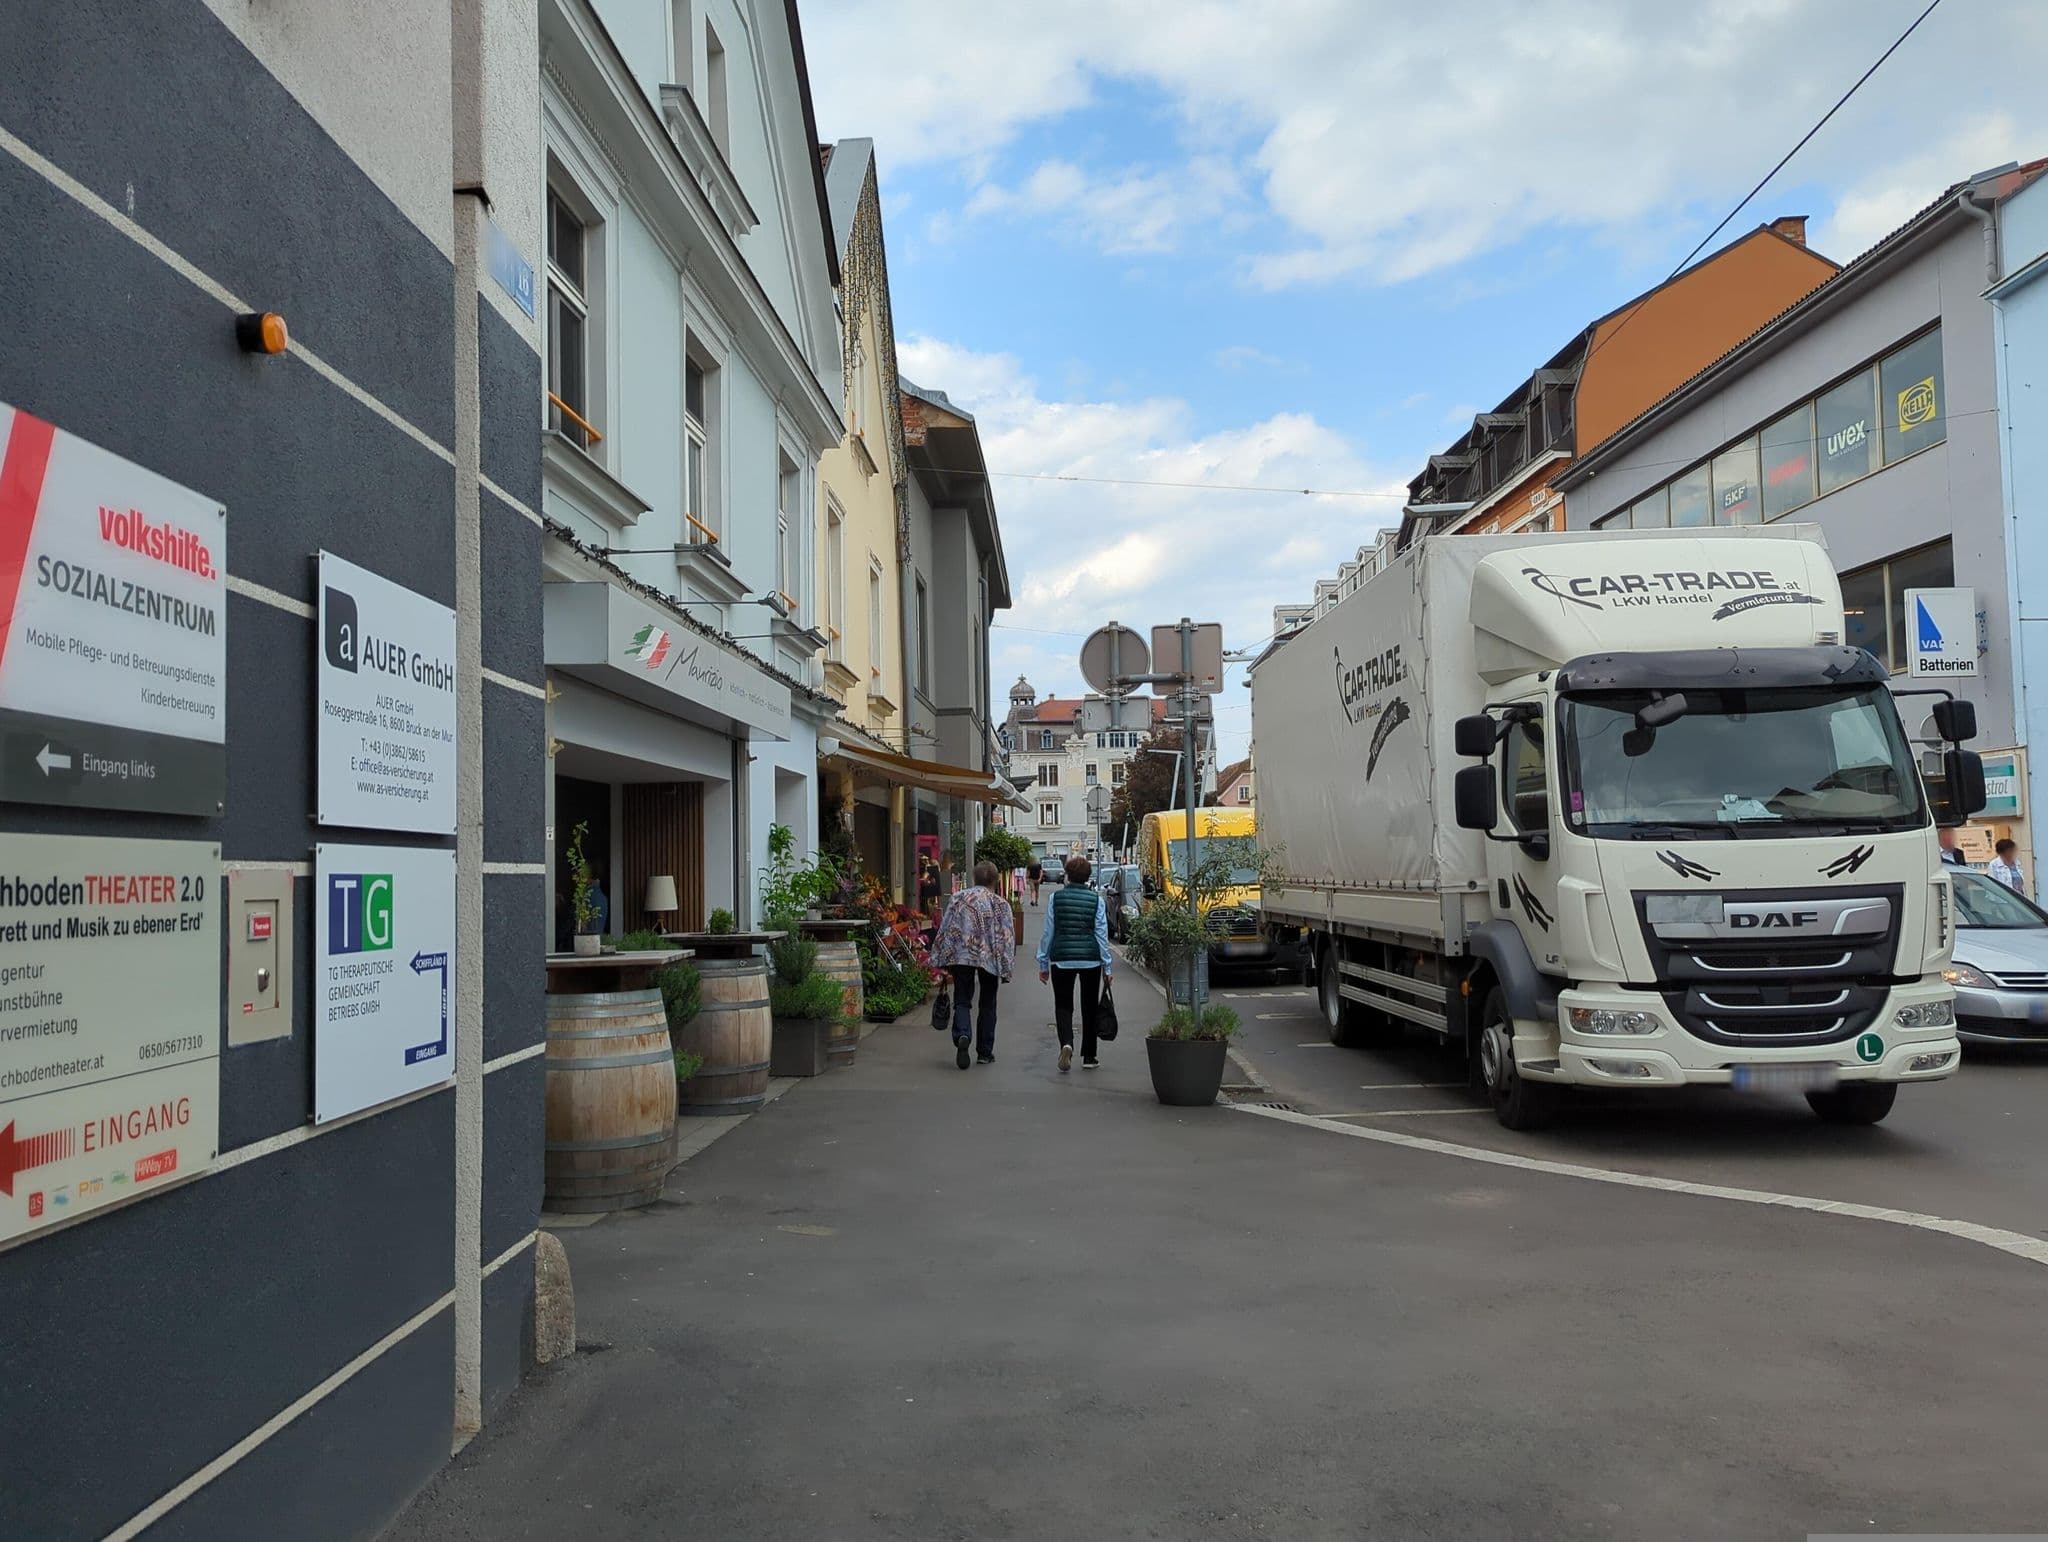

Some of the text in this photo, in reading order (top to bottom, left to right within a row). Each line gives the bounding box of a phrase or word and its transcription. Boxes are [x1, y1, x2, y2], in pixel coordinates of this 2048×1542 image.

[1904, 389, 1933, 415] HELLA
[1828, 420, 1866, 455] uvex
[1725, 486, 1746, 506] SKF
[99, 505, 216, 580] volkshilfe.
[37, 554, 215, 636] SOZIALZENTRUM
[1612, 593, 1713, 607] LKW Handel
[1728, 592, 1794, 613] Vermietung
[26, 628, 216, 687] Mobile Pflege- und Betreuungsdienste
[362, 635, 407, 678] AUER
[411, 652, 453, 693] GmbH
[665, 646, 723, 690] Maurizio
[1920, 658, 1974, 671] Batterien
[141, 688, 215, 719] Kinderbetreuung
[376, 694, 414, 716] AUER GmbH
[324, 700, 377, 726] Roseggerstraße
[379, 713, 388, 729] 16,
[389, 716, 405, 733] 8600
[405, 720, 421, 736] Bruck
[422, 726, 430, 738] an
[431, 726, 441, 740] der
[361, 738, 368, 752] T:
[369, 741, 381, 754] +43
[83, 753, 155, 779] Eingang links
[351, 757, 358, 770] E:
[1985, 779, 2008, 796] strol
[181, 876, 204, 902] 2.0
[32, 918, 62, 941] und
[67, 917, 109, 939] Musik
[114, 920, 129, 936] zu
[133, 915, 177, 934] ebener
[180, 912, 204, 932] Erd'
[1730, 911, 1818, 929] DAF
[329, 960, 393, 980] TG THERAPEUTISCHE
[329, 981, 380, 1001] GEMEINSCHAFT
[329, 1000, 380, 1021] BETRIEBS GMBH
[139, 1035, 203, 1060] 0650/5677310
[416, 1045, 437, 1060] EINGANG
[1864, 1039, 1877, 1058] L
[84, 1097, 190, 1152] EINGANG
